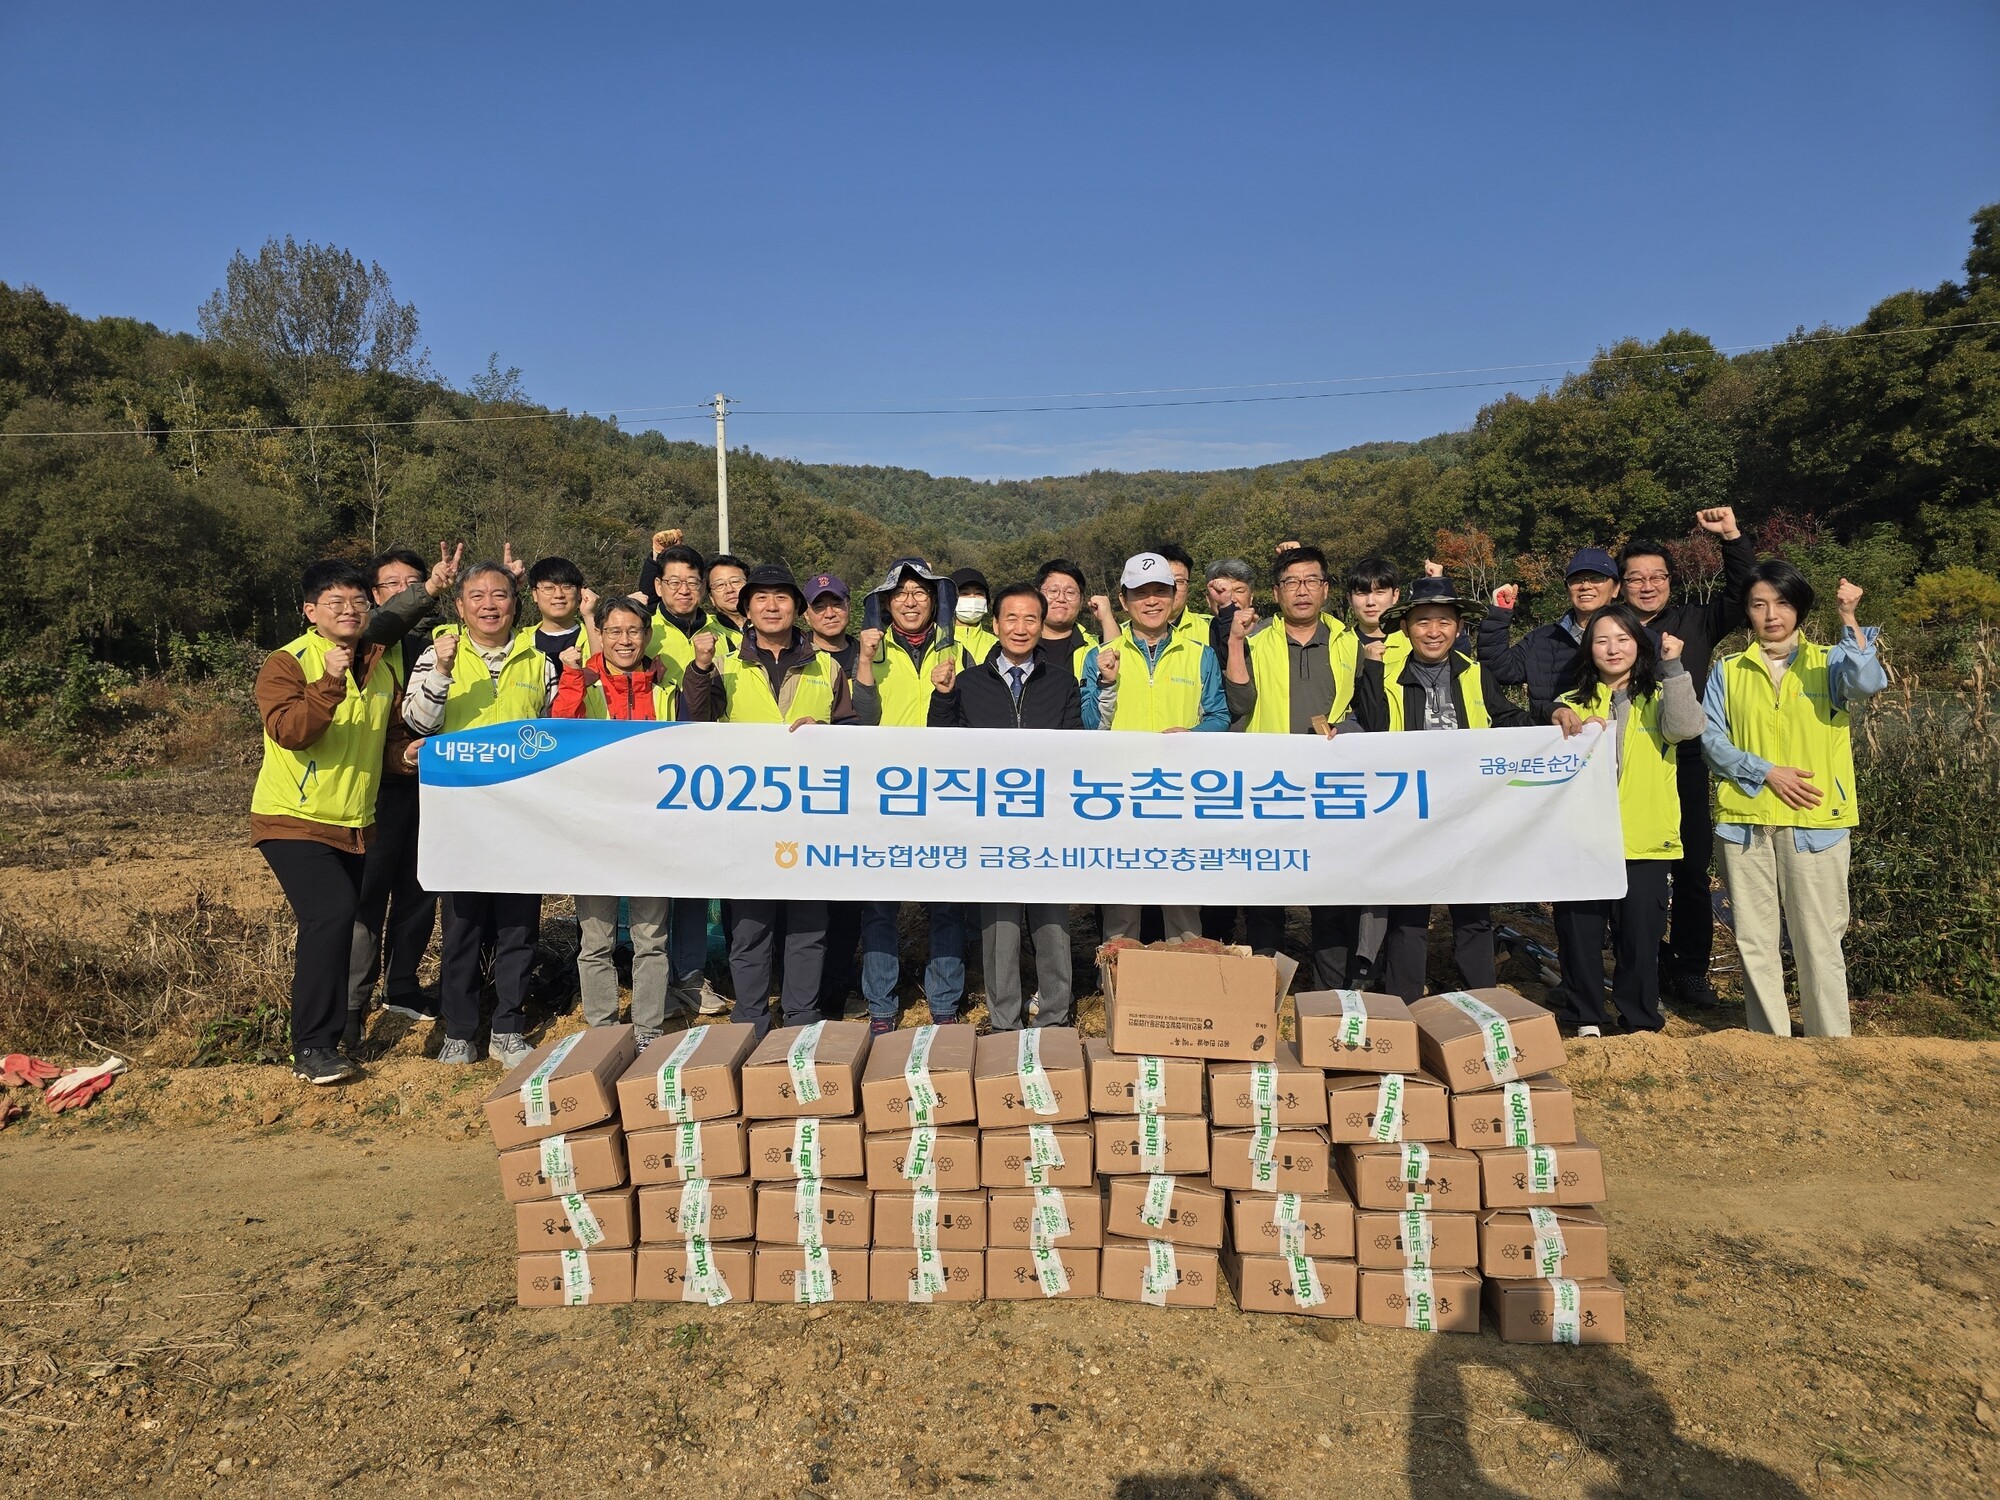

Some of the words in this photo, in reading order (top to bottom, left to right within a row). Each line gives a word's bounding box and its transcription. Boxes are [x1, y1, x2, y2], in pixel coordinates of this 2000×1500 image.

[436, 741, 516, 764] 내맘같이
[1479, 757, 1519, 776] 금융의
[1519, 757, 1545, 774] 모든
[1547, 753, 1580, 773] 순간
[656, 763, 850, 816] 2025년
[875, 765, 1046, 818] 임직원
[1071, 767, 1429, 821] 농촌일손돕기
[806, 844, 968, 870] NH농협생명
[980, 846, 1310, 872] 금융소비자보호총괄책임자
